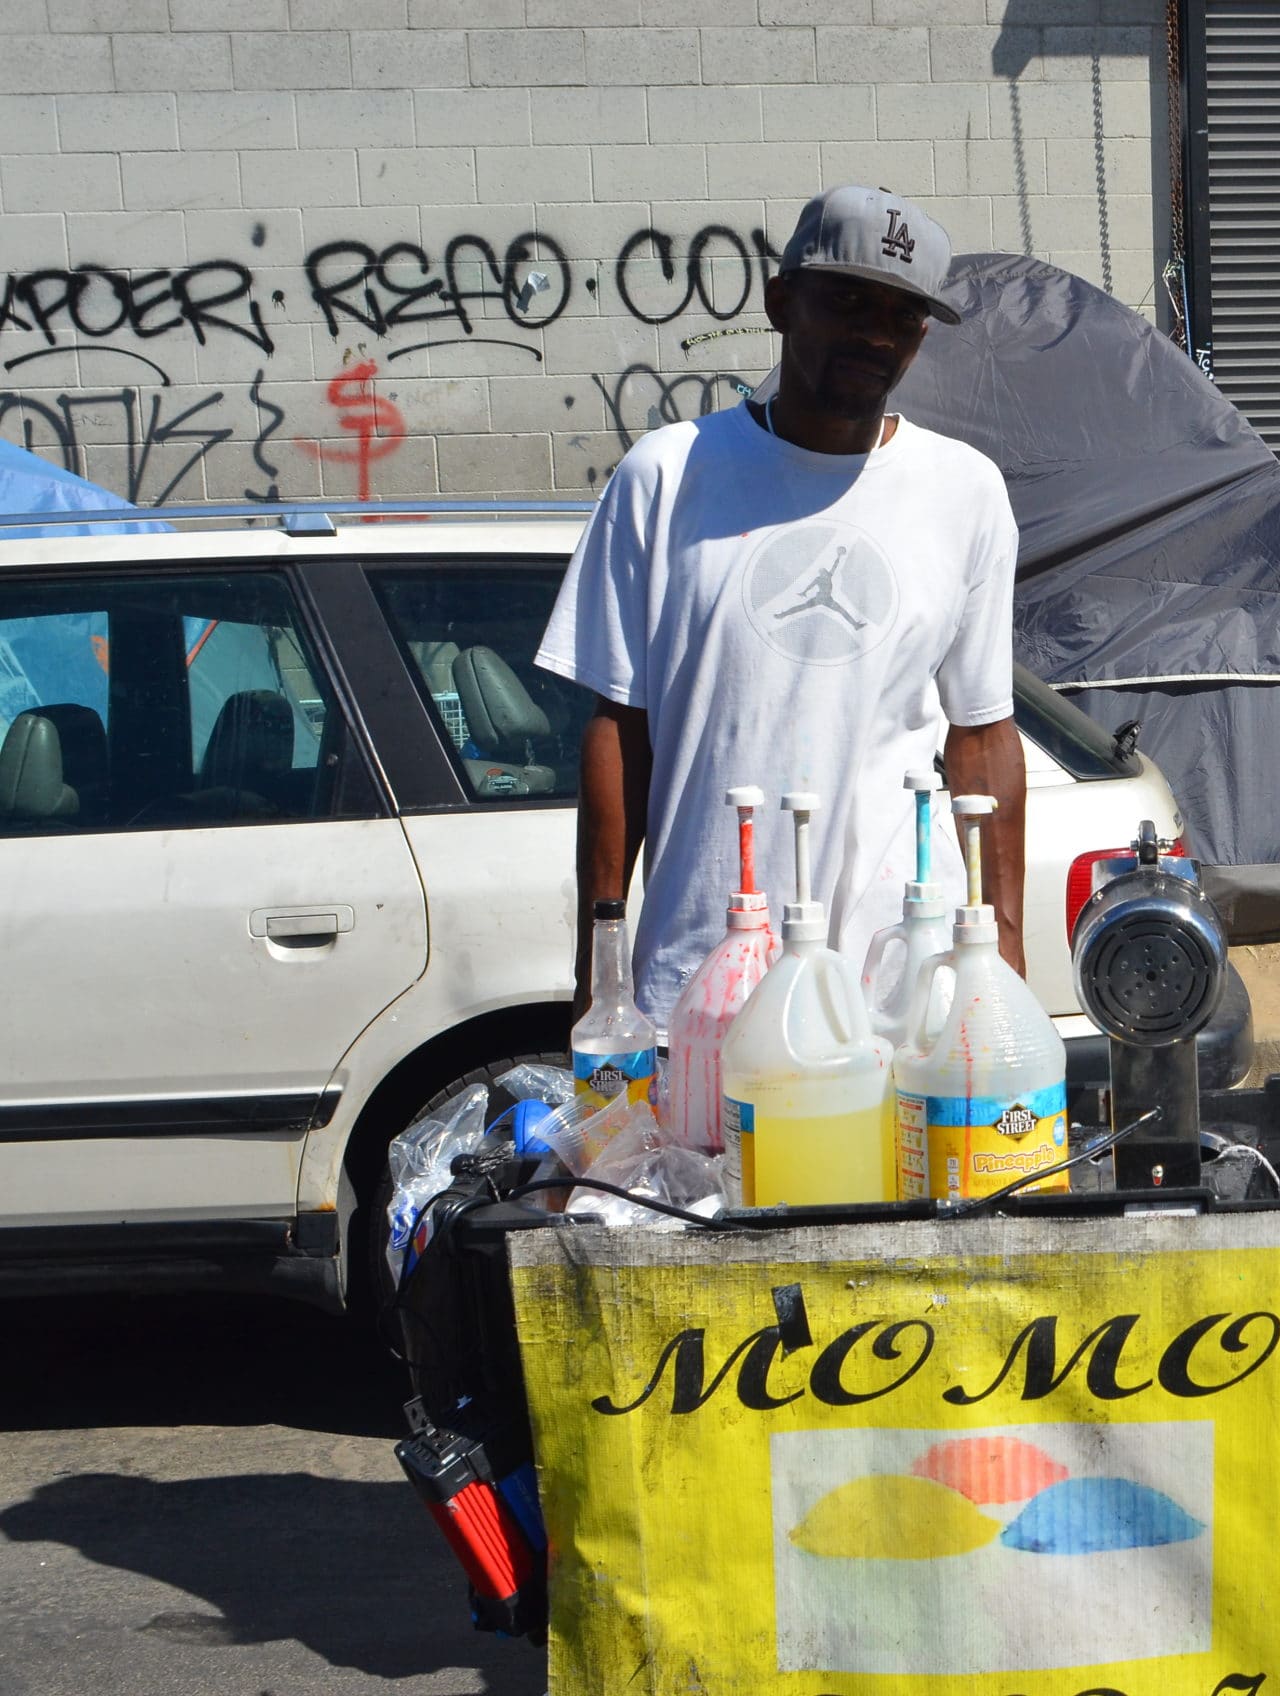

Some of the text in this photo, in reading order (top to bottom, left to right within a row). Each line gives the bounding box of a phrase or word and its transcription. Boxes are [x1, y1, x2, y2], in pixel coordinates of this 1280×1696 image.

[881, 208, 916, 264] LA
[592, 1068, 625, 1081] FIRST
[1001, 1109, 1033, 1124] FIRST
[996, 1119, 1038, 1135] STREET
[973, 1143, 1055, 1173] Pineapple
